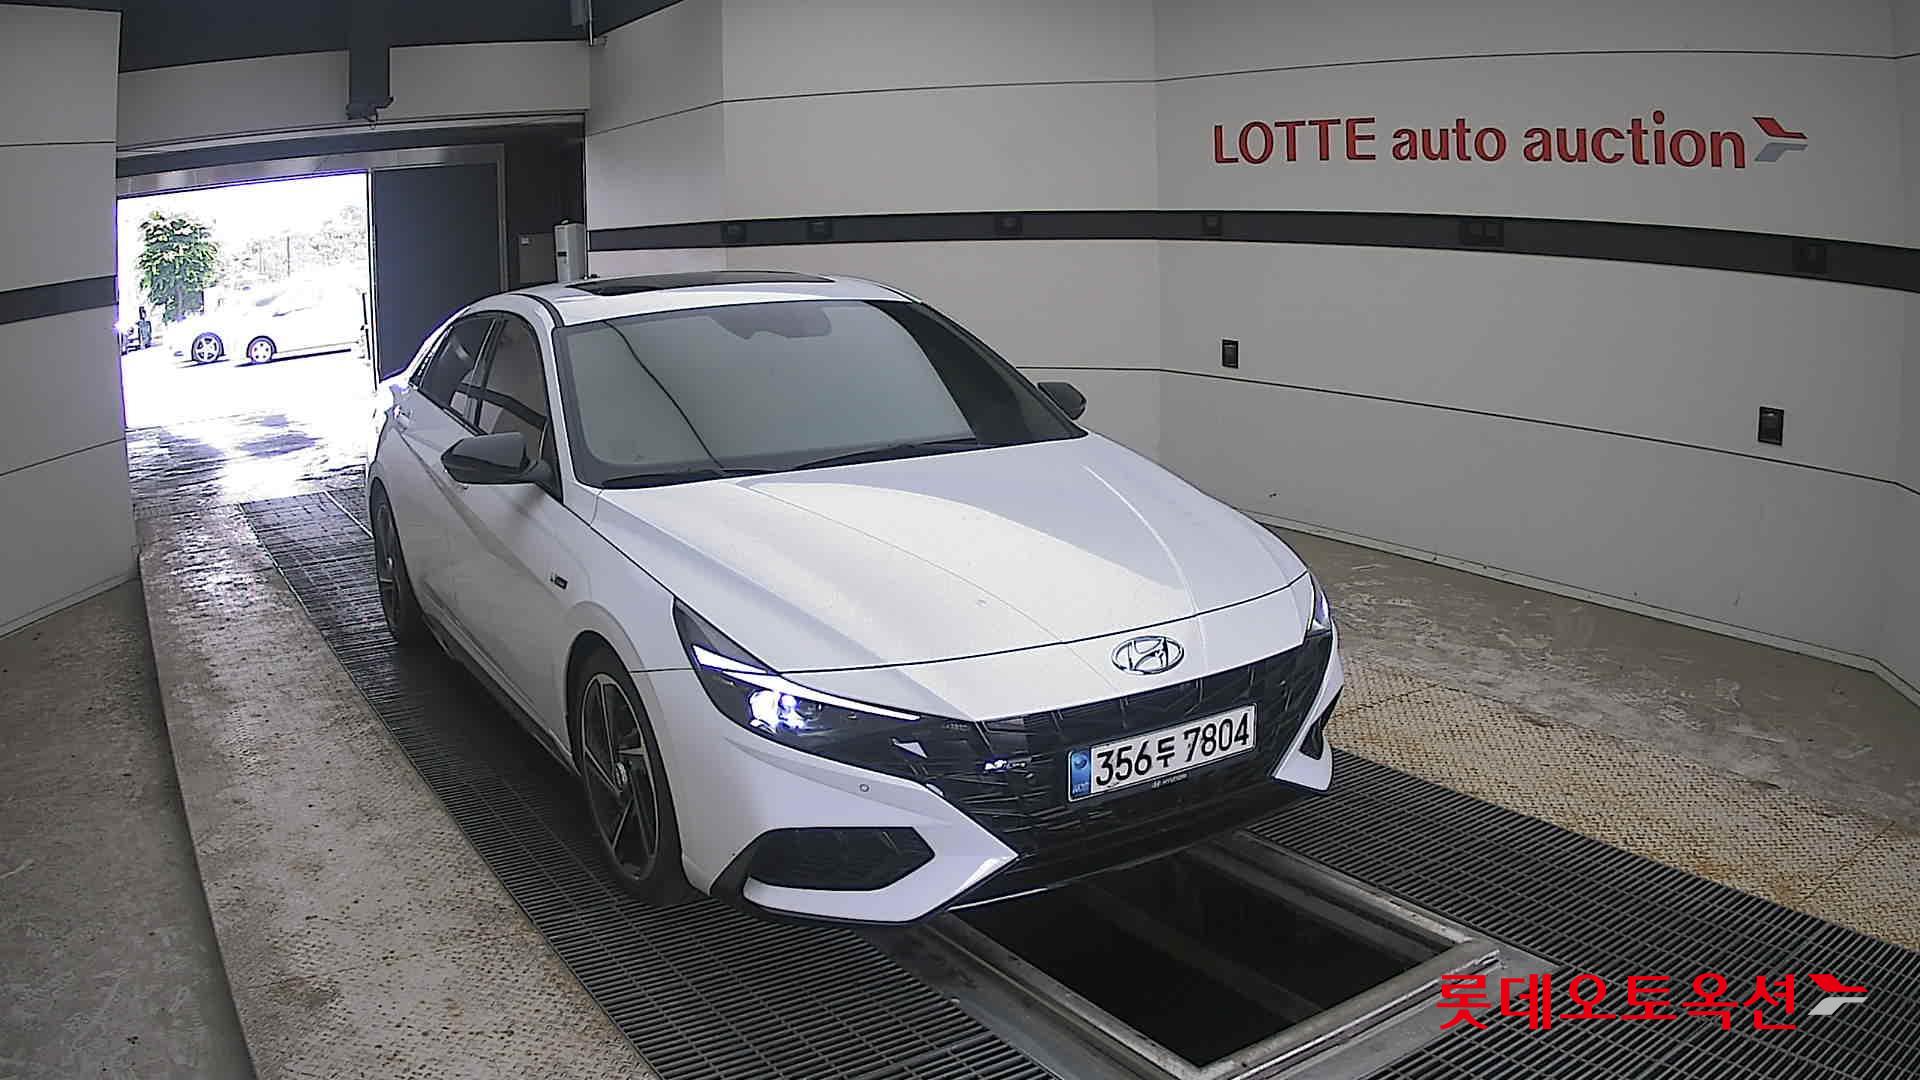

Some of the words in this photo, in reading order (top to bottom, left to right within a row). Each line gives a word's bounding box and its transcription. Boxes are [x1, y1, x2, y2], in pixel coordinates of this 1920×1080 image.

[1214, 117, 1376, 165] LOTTE
[1392, 118, 1507, 162] auto
[1523, 110, 1746, 169] auction
[1095, 735, 1176, 786] 356두
[1183, 712, 1250, 763] 7804
